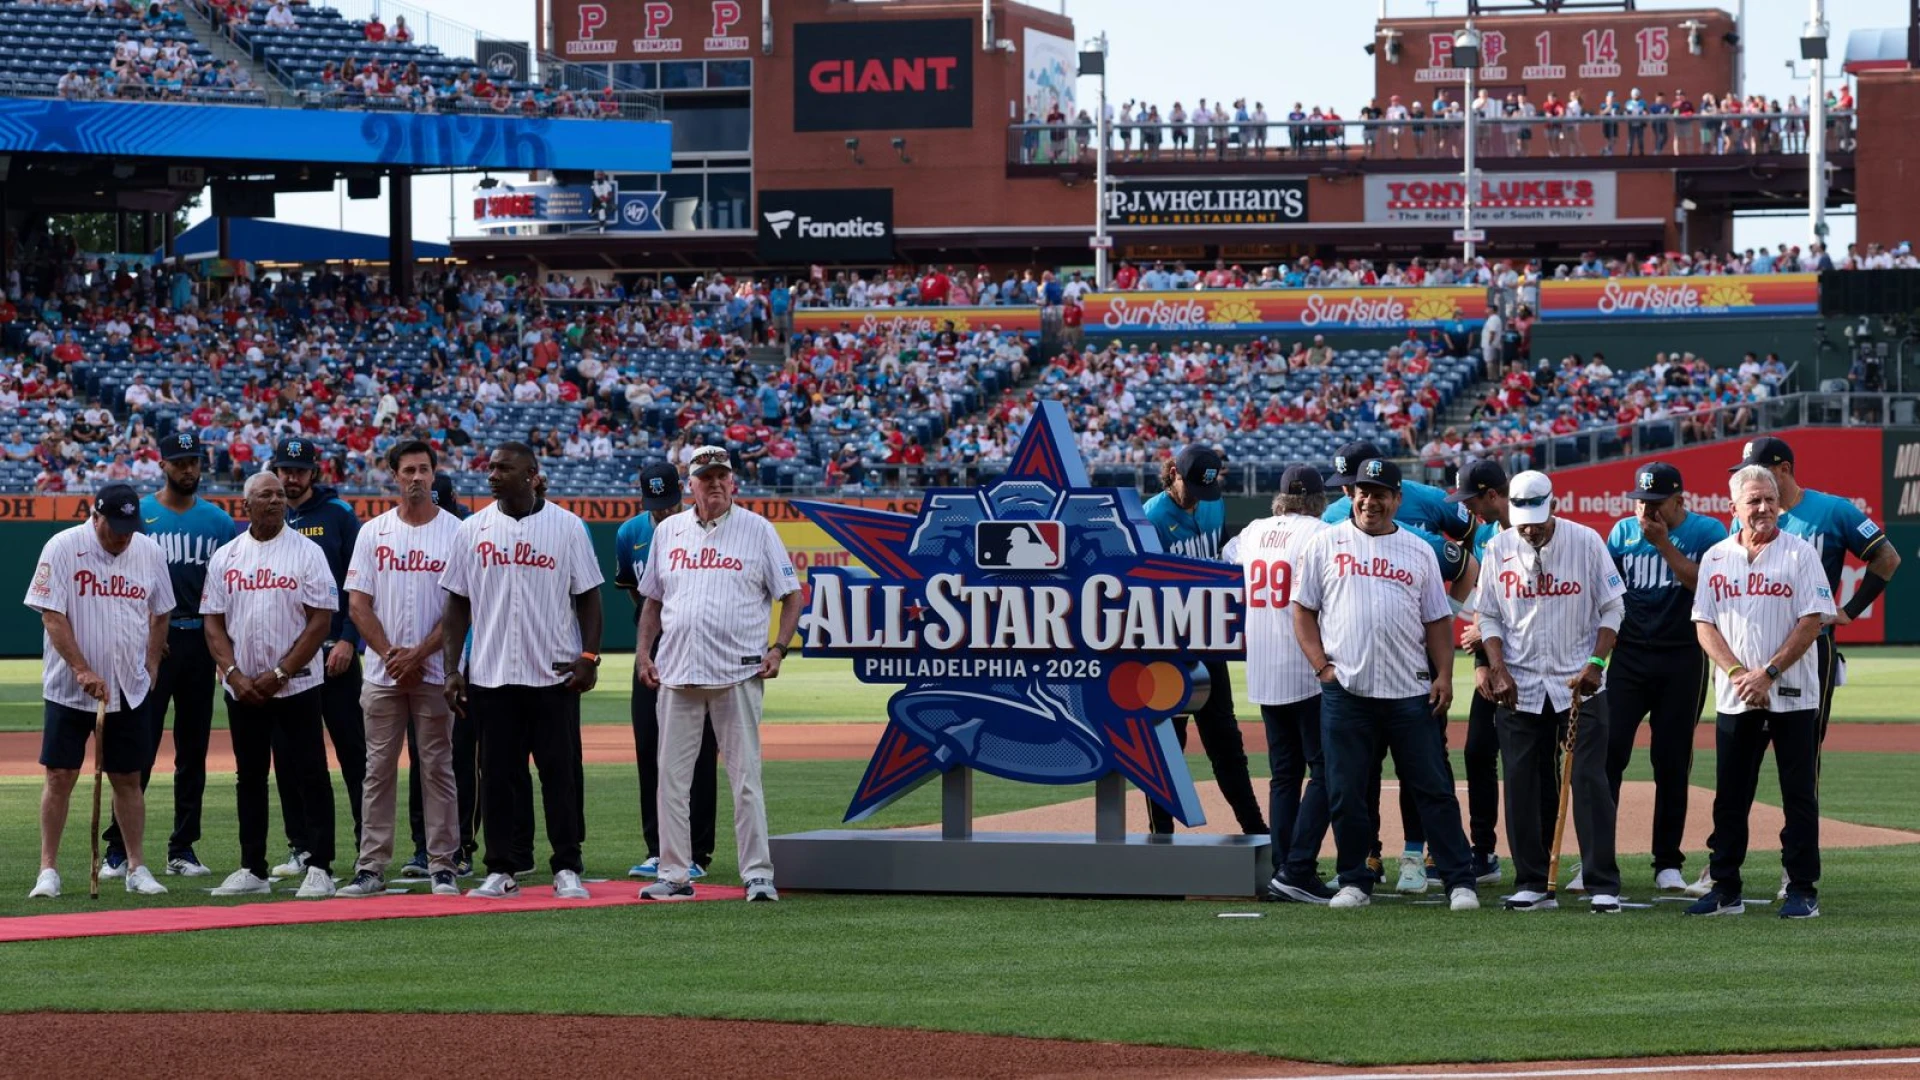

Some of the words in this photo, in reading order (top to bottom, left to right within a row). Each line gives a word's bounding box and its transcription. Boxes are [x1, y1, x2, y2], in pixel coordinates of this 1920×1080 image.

[579, 5, 606, 39] P
[645, 3, 672, 38] P
[712, 1, 740, 37] P
[1536, 31, 1550, 65] 1
[1583, 29, 1616, 64] 14
[1636, 27, 1668, 62] 15
[809, 57, 957, 93] GIANT
[1387, 182, 1468, 200] TONY
[1481, 180, 1594, 199] LUKE'S
[797, 216, 886, 238] Fanatics
[1128, 215, 1159, 224] PUB
[1173, 213, 1277, 223] RESTAURANT
[1425, 208, 1451, 220] Real
[1510, 207, 1544, 219] South
[1550, 207, 1583, 220] Philly
[1301, 293, 1404, 326] Surfside
[1598, 280, 1698, 313] Surfside
[1103, 297, 1205, 330] Surfside
[478, 541, 556, 570] Phillies
[1259, 530, 1294, 550] KRUK
[669, 548, 743, 572] Phillies
[1334, 553, 1414, 587] Phillies
[74, 569, 147, 600] Phillies
[224, 569, 299, 595] Phillies
[1249, 559, 1292, 609] 29
[1498, 570, 1582, 599] Phillies
[1708, 573, 1794, 602] Phillies
[798, 573, 918, 649] ALL
[923, 572, 1080, 650] STAR
[1080, 573, 1245, 650] GAME
[865, 658, 1028, 678] PHILADELPHIA
[1045, 658, 1102, 678] 2026
